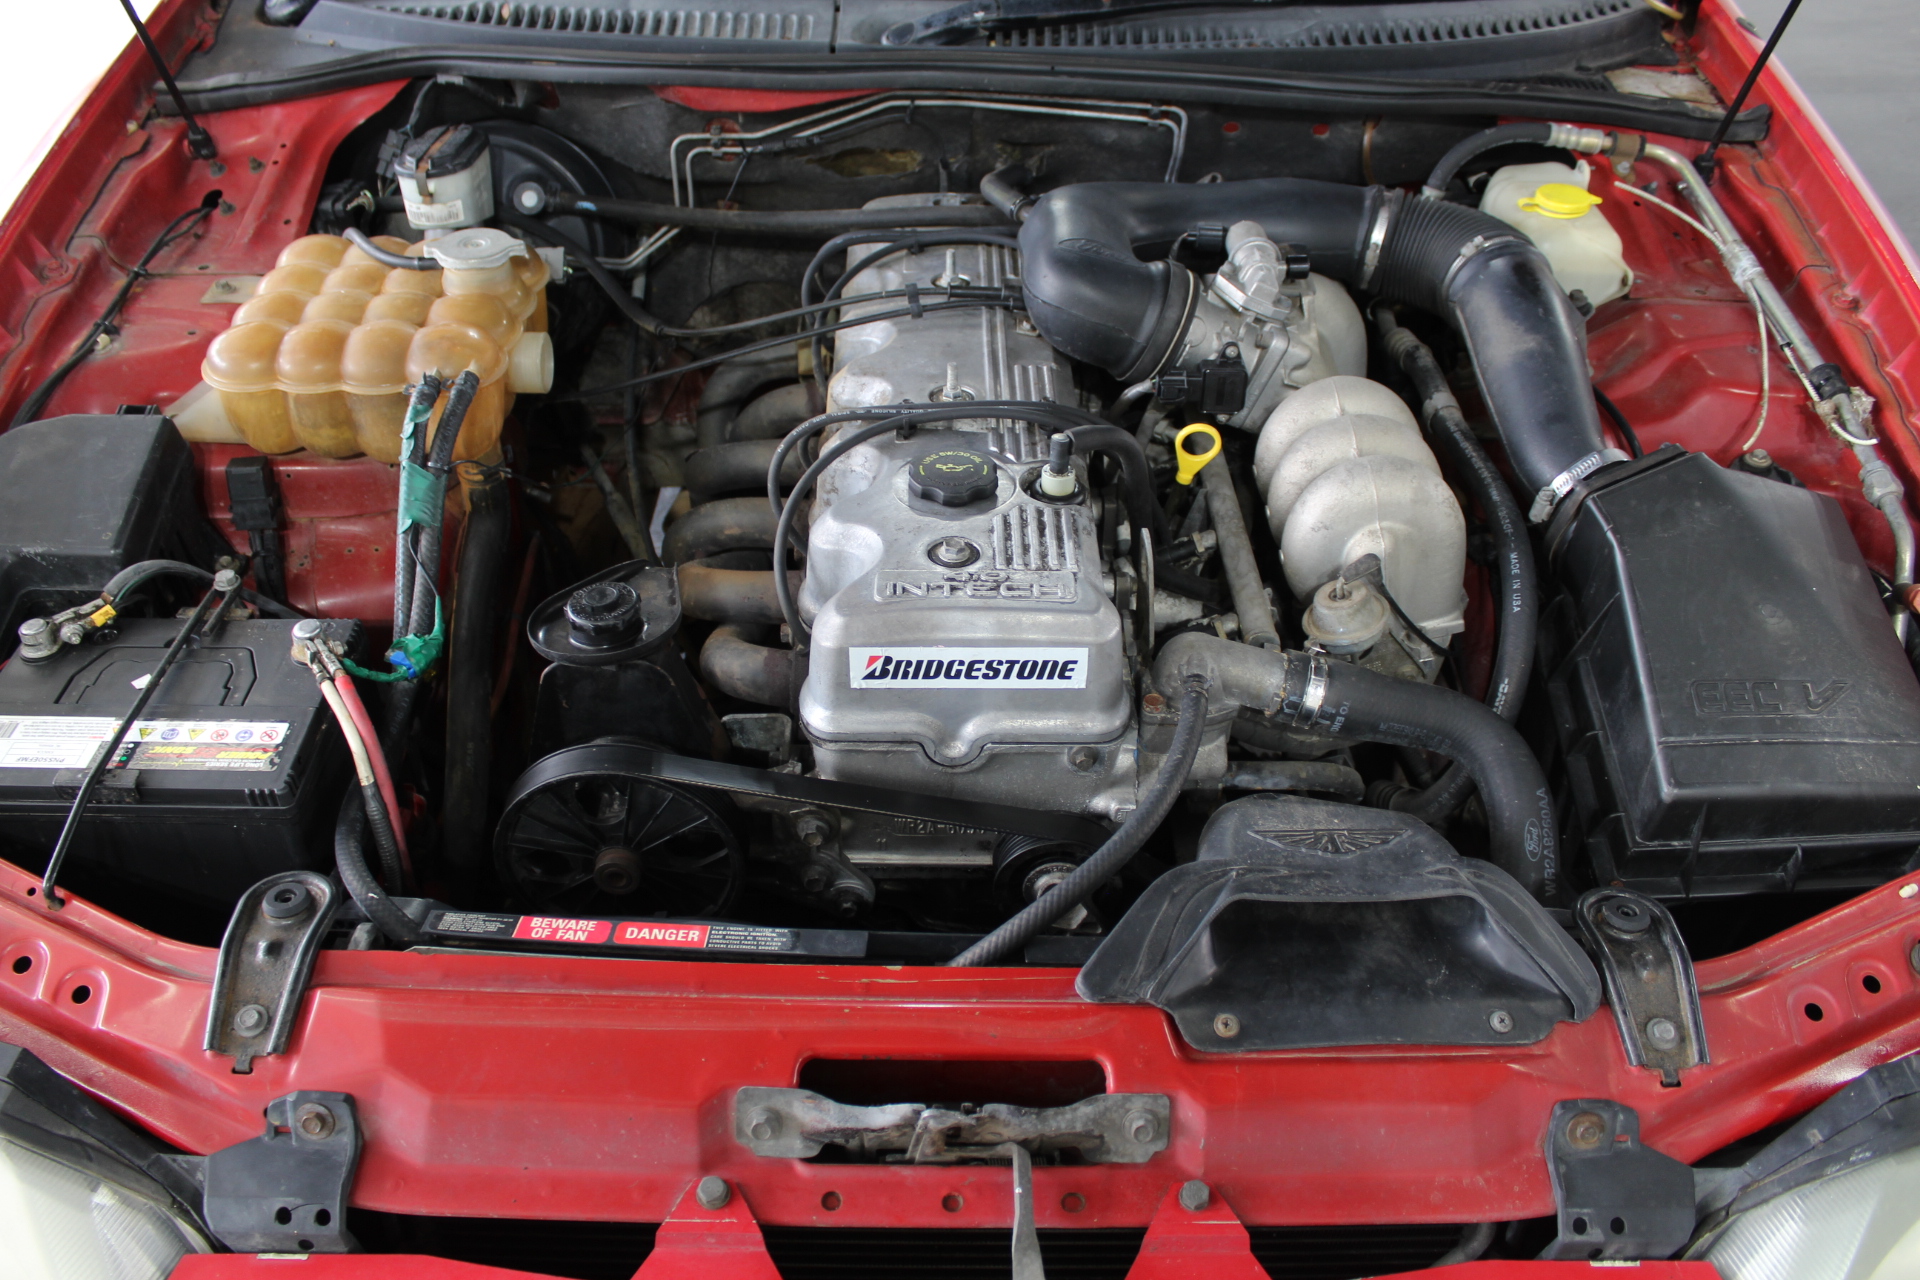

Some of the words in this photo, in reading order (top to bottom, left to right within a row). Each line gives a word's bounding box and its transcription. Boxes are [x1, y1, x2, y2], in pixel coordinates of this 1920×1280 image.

[921, 453, 940, 464] USE
[1508, 551, 1521, 576] MADE
[886, 581, 1068, 599] INTECH
[1511, 579, 1522, 590] IN
[1511, 593, 1522, 614] USA
[861, 655, 1079, 681] BRIDGESTONE
[1694, 681, 1785, 715] EEC
[148, 745, 198, 754] SONIC
[1526, 826, 1540, 853] Ford
[1536, 787, 1557, 897] WR2AB260AA
[530, 917, 597, 931] BEWARE
[531, 927, 552, 938] OF
[556, 928, 588, 941] FAN
[624, 927, 700, 942] DANGER
